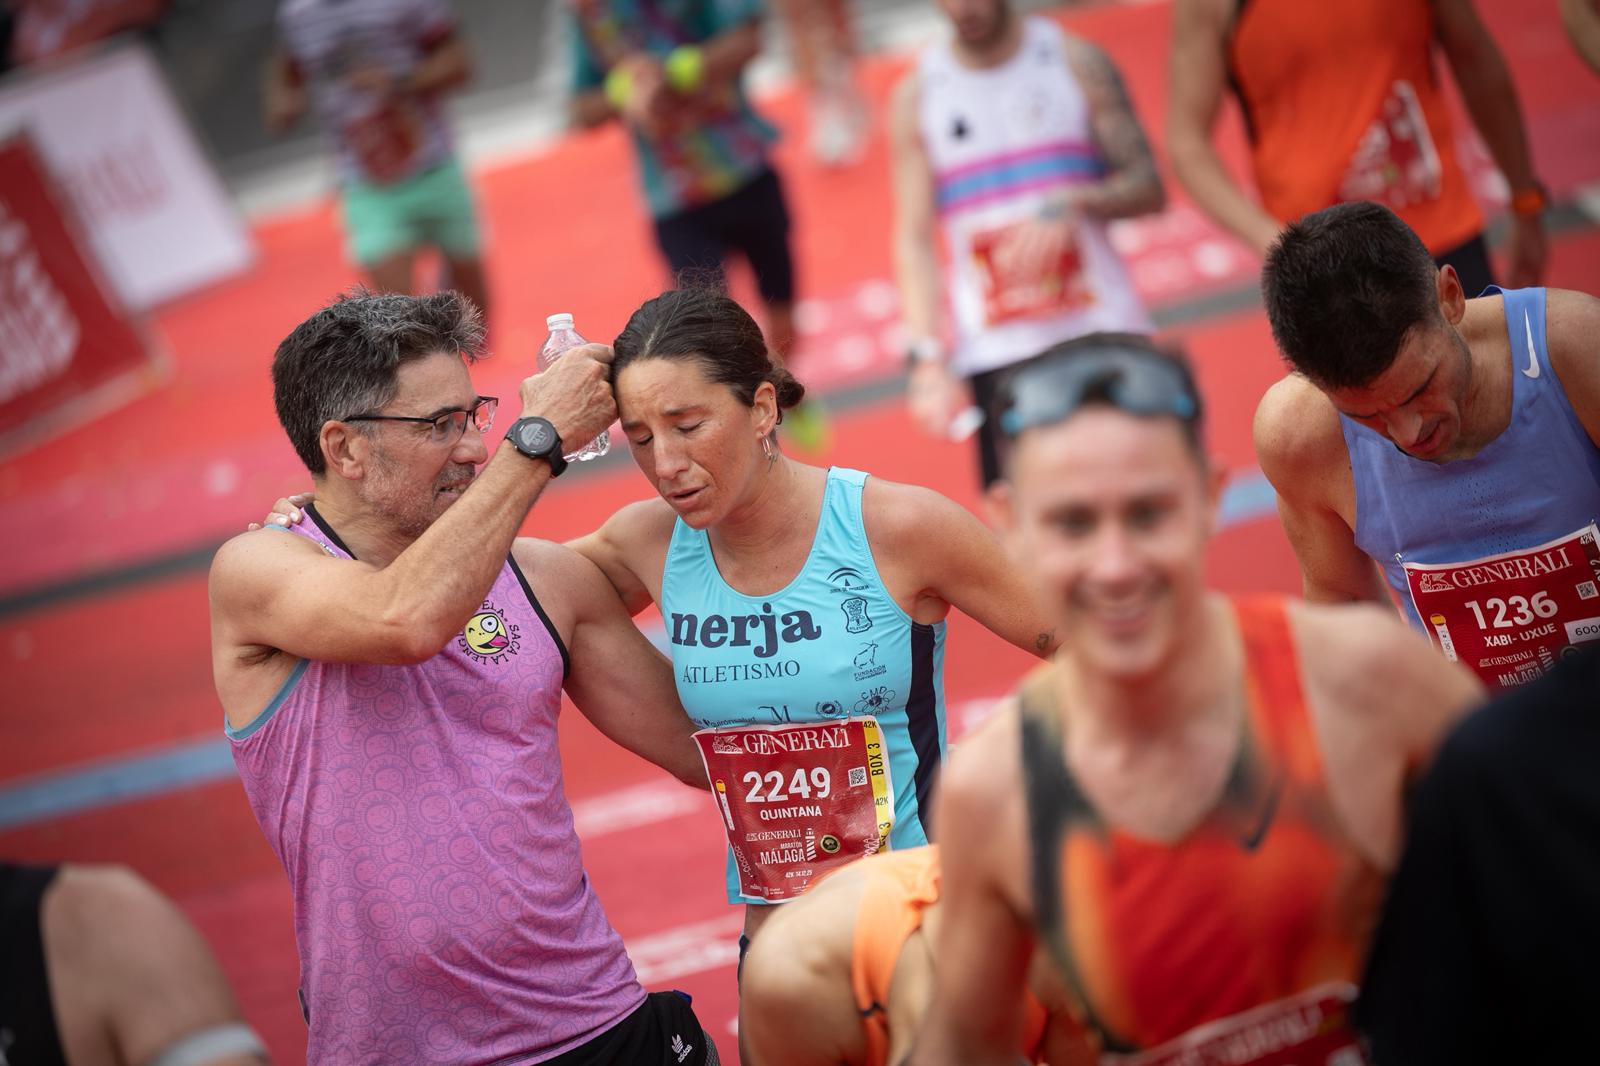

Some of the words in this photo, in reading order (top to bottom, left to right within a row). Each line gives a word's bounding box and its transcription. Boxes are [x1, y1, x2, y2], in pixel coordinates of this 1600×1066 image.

[1451, 547, 1573, 588] GENERALI
[1464, 591, 1559, 631] 1236
[671, 602, 822, 658] nerja
[1520, 623, 1558, 642] UXUE
[1490, 650, 1534, 666] GENERALI
[682, 660, 800, 684] ATLETISMO
[1497, 667, 1544, 688] MÁLAGA
[863, 721, 877, 729] 42K
[743, 727, 851, 755] GENERALI
[869, 753, 884, 777] BOX
[742, 767, 831, 803] 2249
[759, 805, 823, 821] QUINTANA
[758, 829, 802, 841] GENERALI
[760, 848, 806, 865] MÁLAGA
